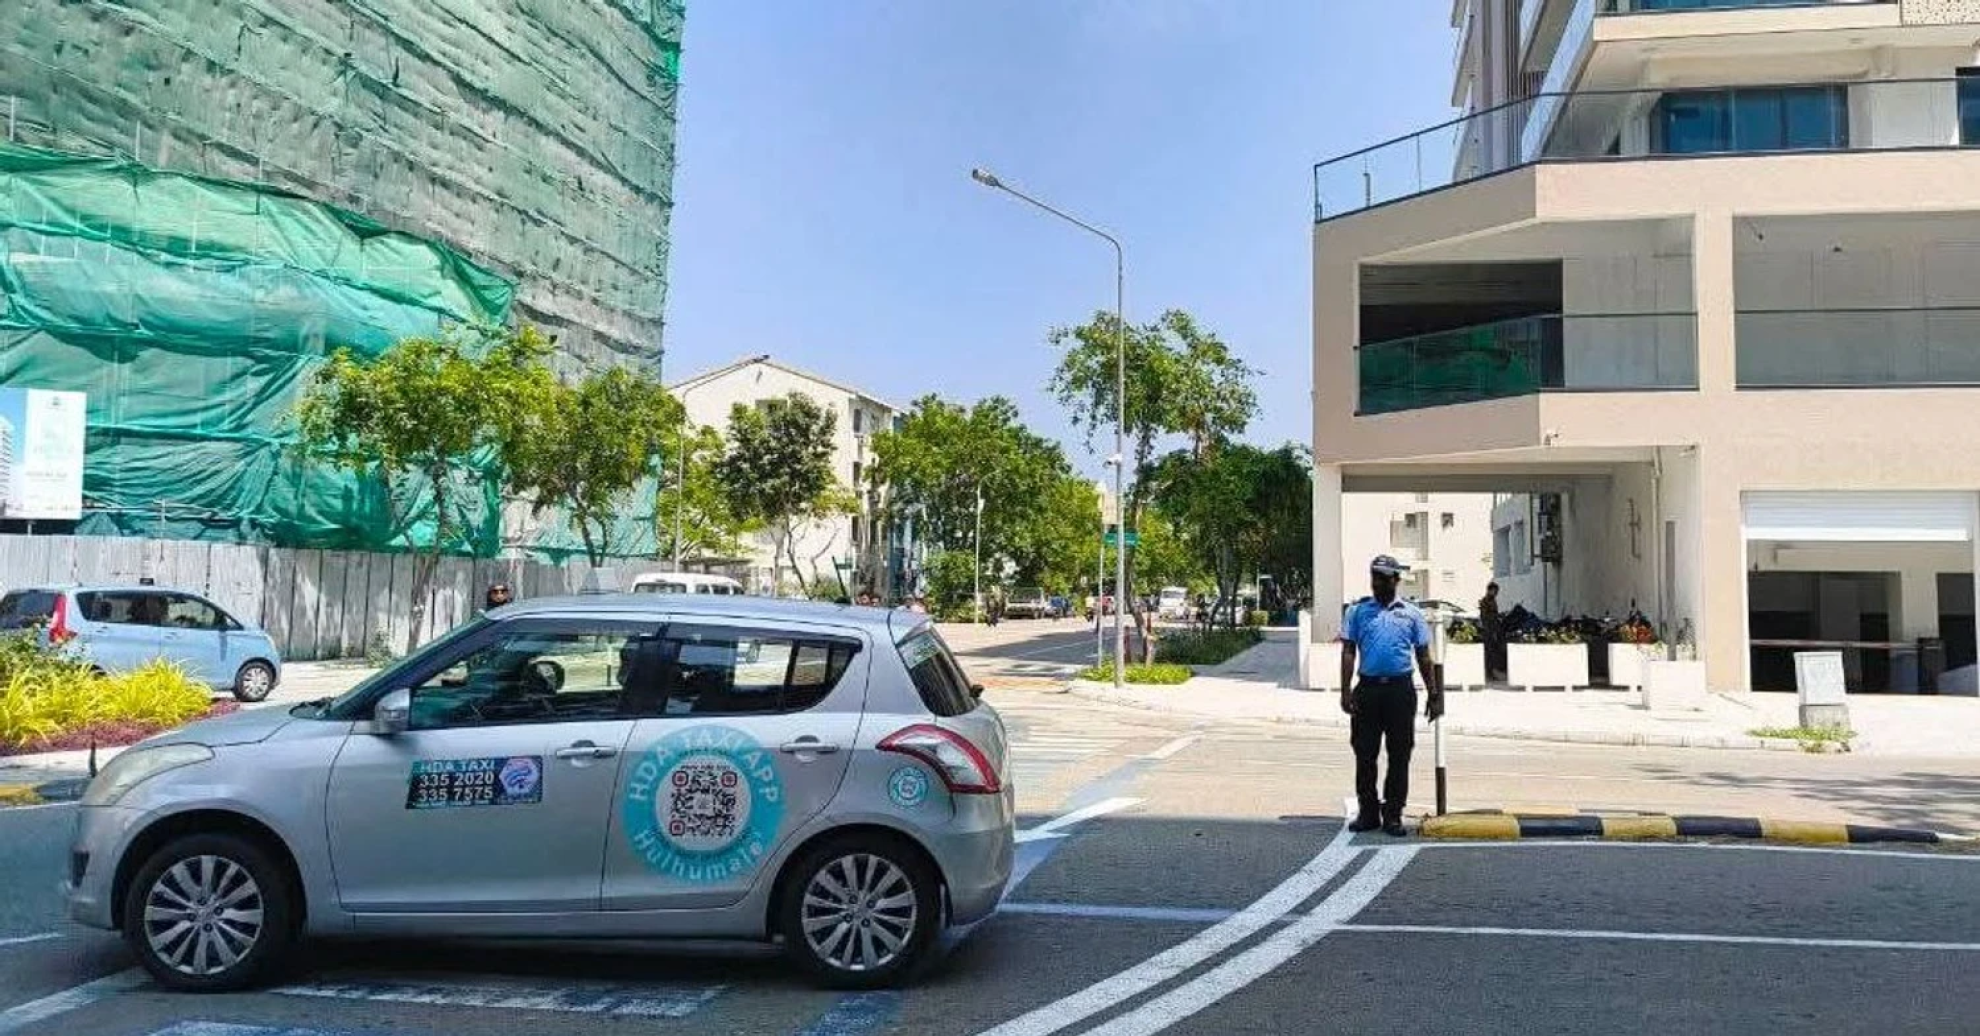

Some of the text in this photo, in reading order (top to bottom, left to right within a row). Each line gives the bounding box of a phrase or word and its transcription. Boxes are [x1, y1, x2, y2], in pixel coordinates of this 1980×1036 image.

[421, 758, 495, 773] HDA TAXI
[629, 729, 778, 801] HDA TAXI APP
[419, 771, 495, 787] 335 2020
[418, 785, 494, 802] 335 7575
